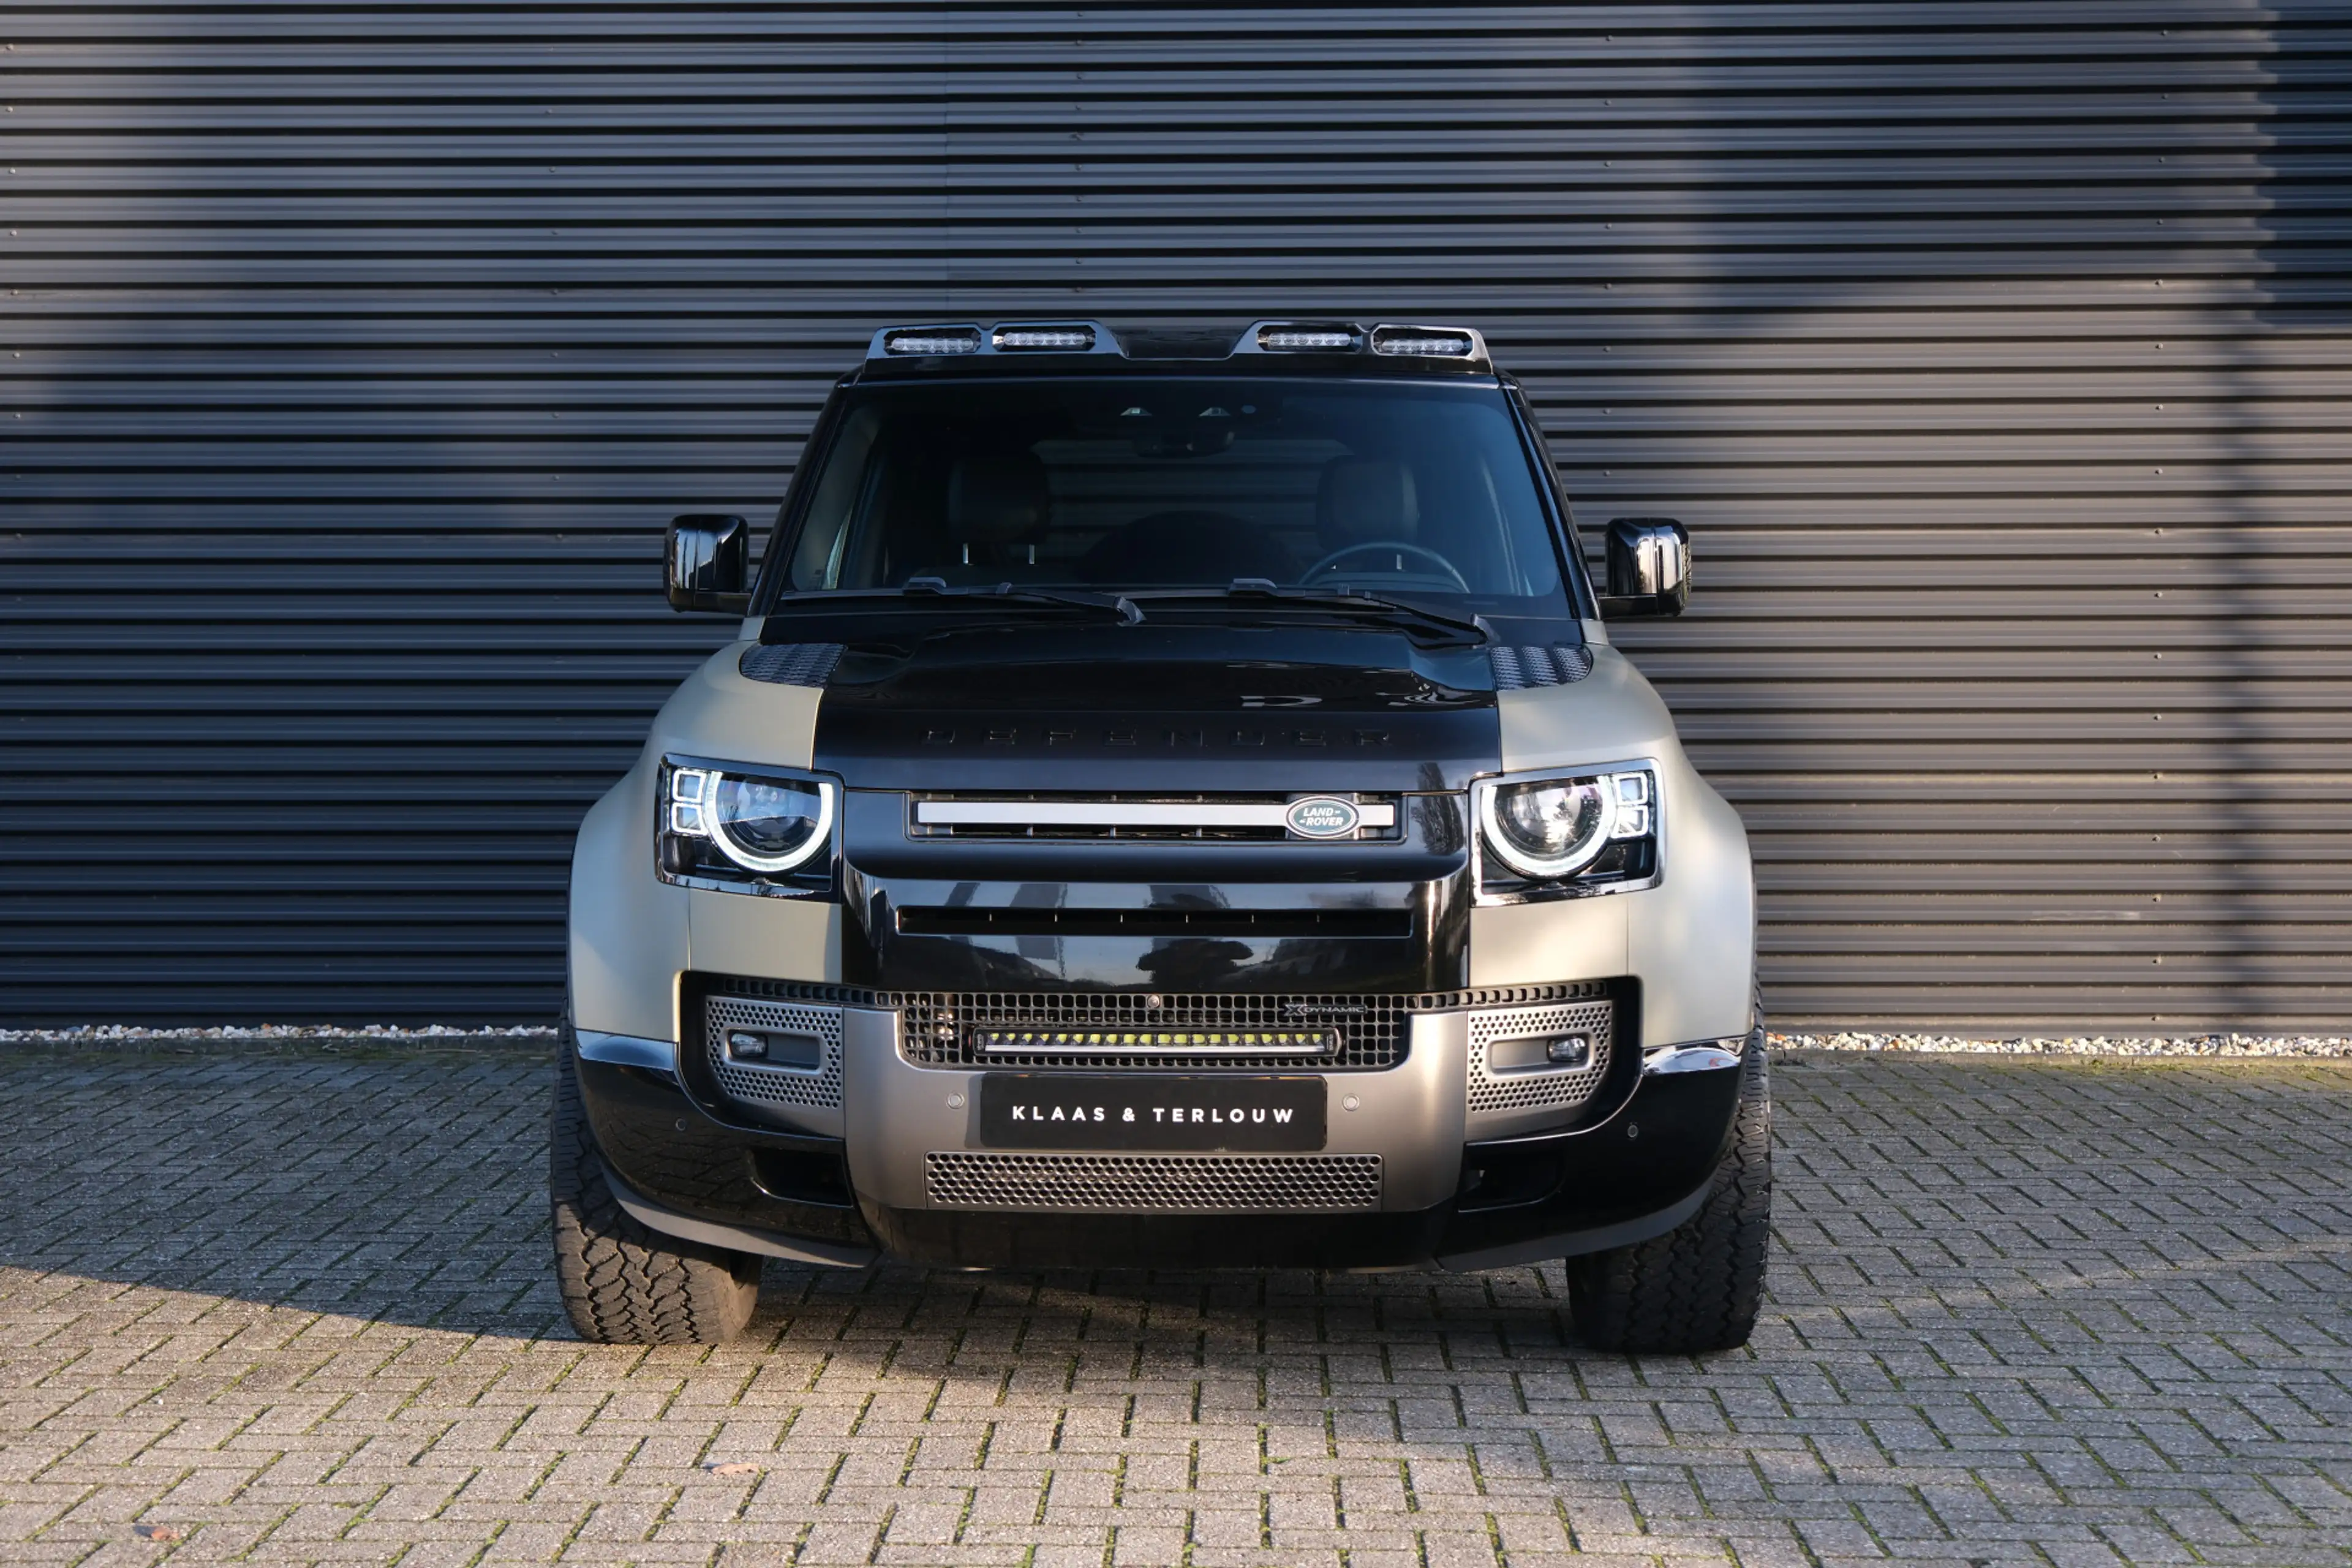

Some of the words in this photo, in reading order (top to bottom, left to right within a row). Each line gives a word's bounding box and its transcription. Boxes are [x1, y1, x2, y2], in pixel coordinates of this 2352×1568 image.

[922, 727, 1392, 747] DEFENDER
[1303, 808, 1334, 816] LAND
[1306, 817, 1344, 826] ROVER
[1012, 1106, 1105, 1121] KLAAS
[1121, 1107, 1136, 1122] &
[1152, 1107, 1293, 1123] TERLOUW
